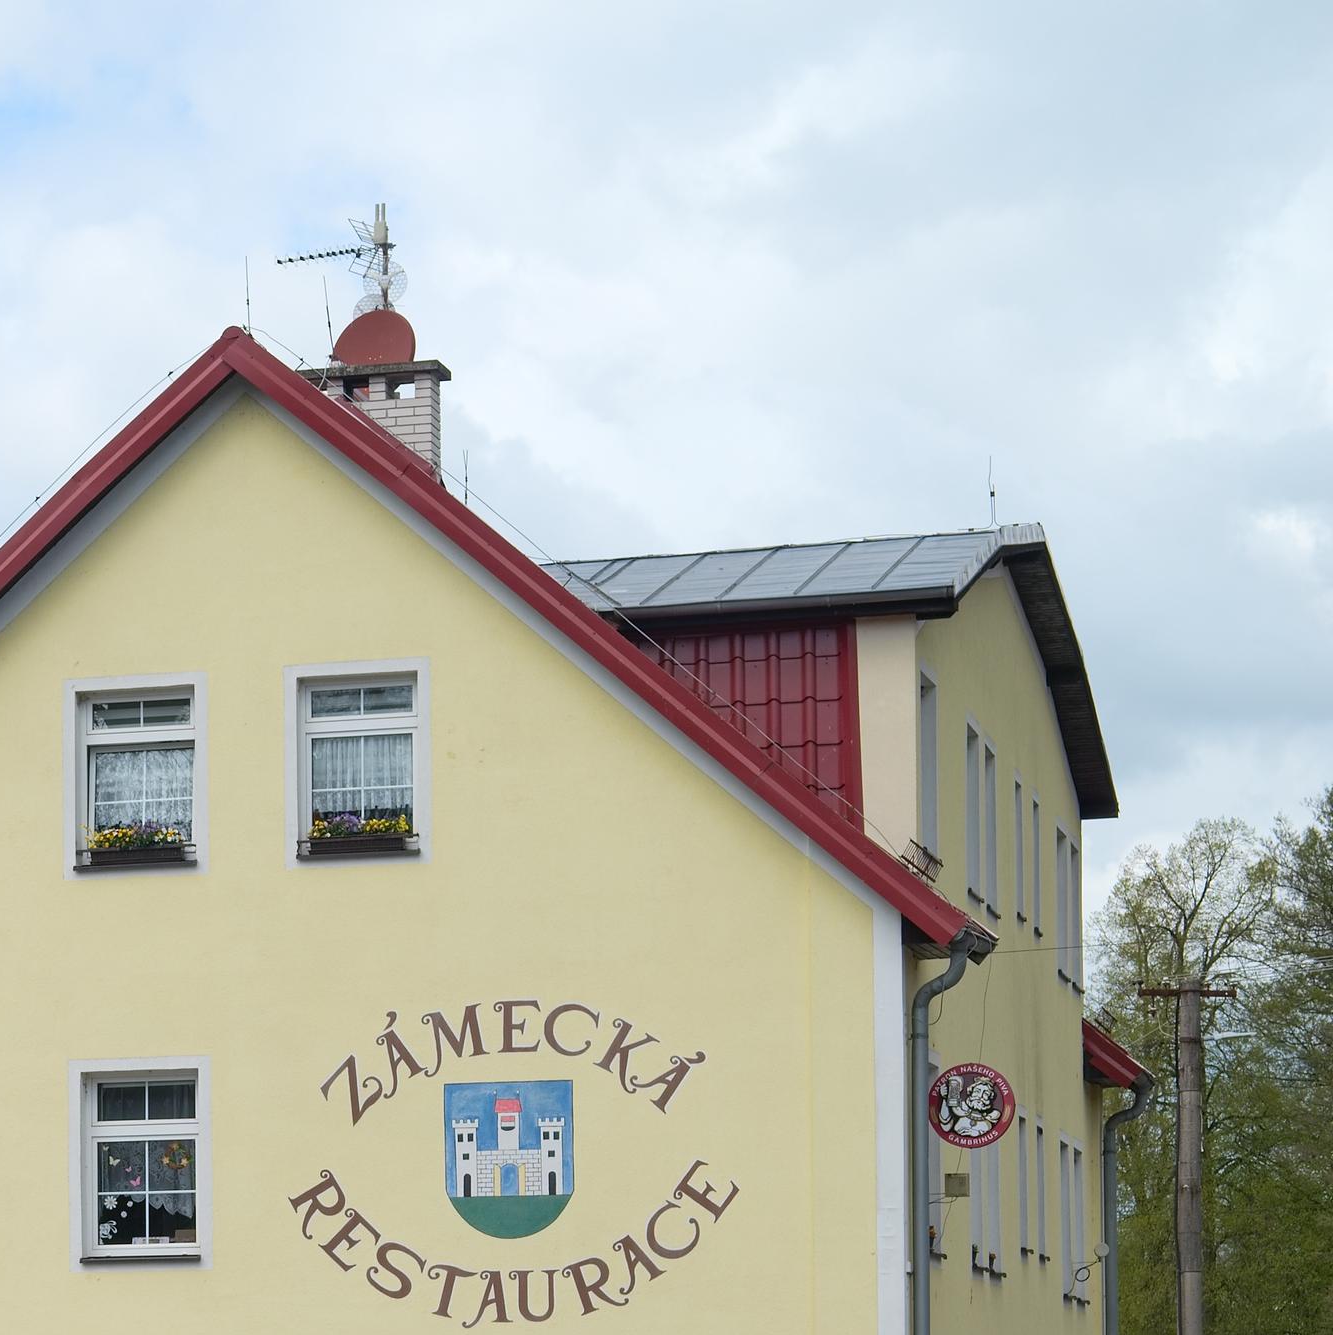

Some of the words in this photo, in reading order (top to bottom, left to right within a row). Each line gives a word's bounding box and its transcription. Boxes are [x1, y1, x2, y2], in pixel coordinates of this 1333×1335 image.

[320, 1000, 706, 1127] ZÁMECKÁ
[932, 1070, 957, 1096] PATRON
[960, 1065, 995, 1078] NAŠEHO
[996, 1078, 1009, 1096] PIVA
[948, 1130, 999, 1145] GAMBRINUS
[288, 1160, 740, 1328] RESTAURACE
